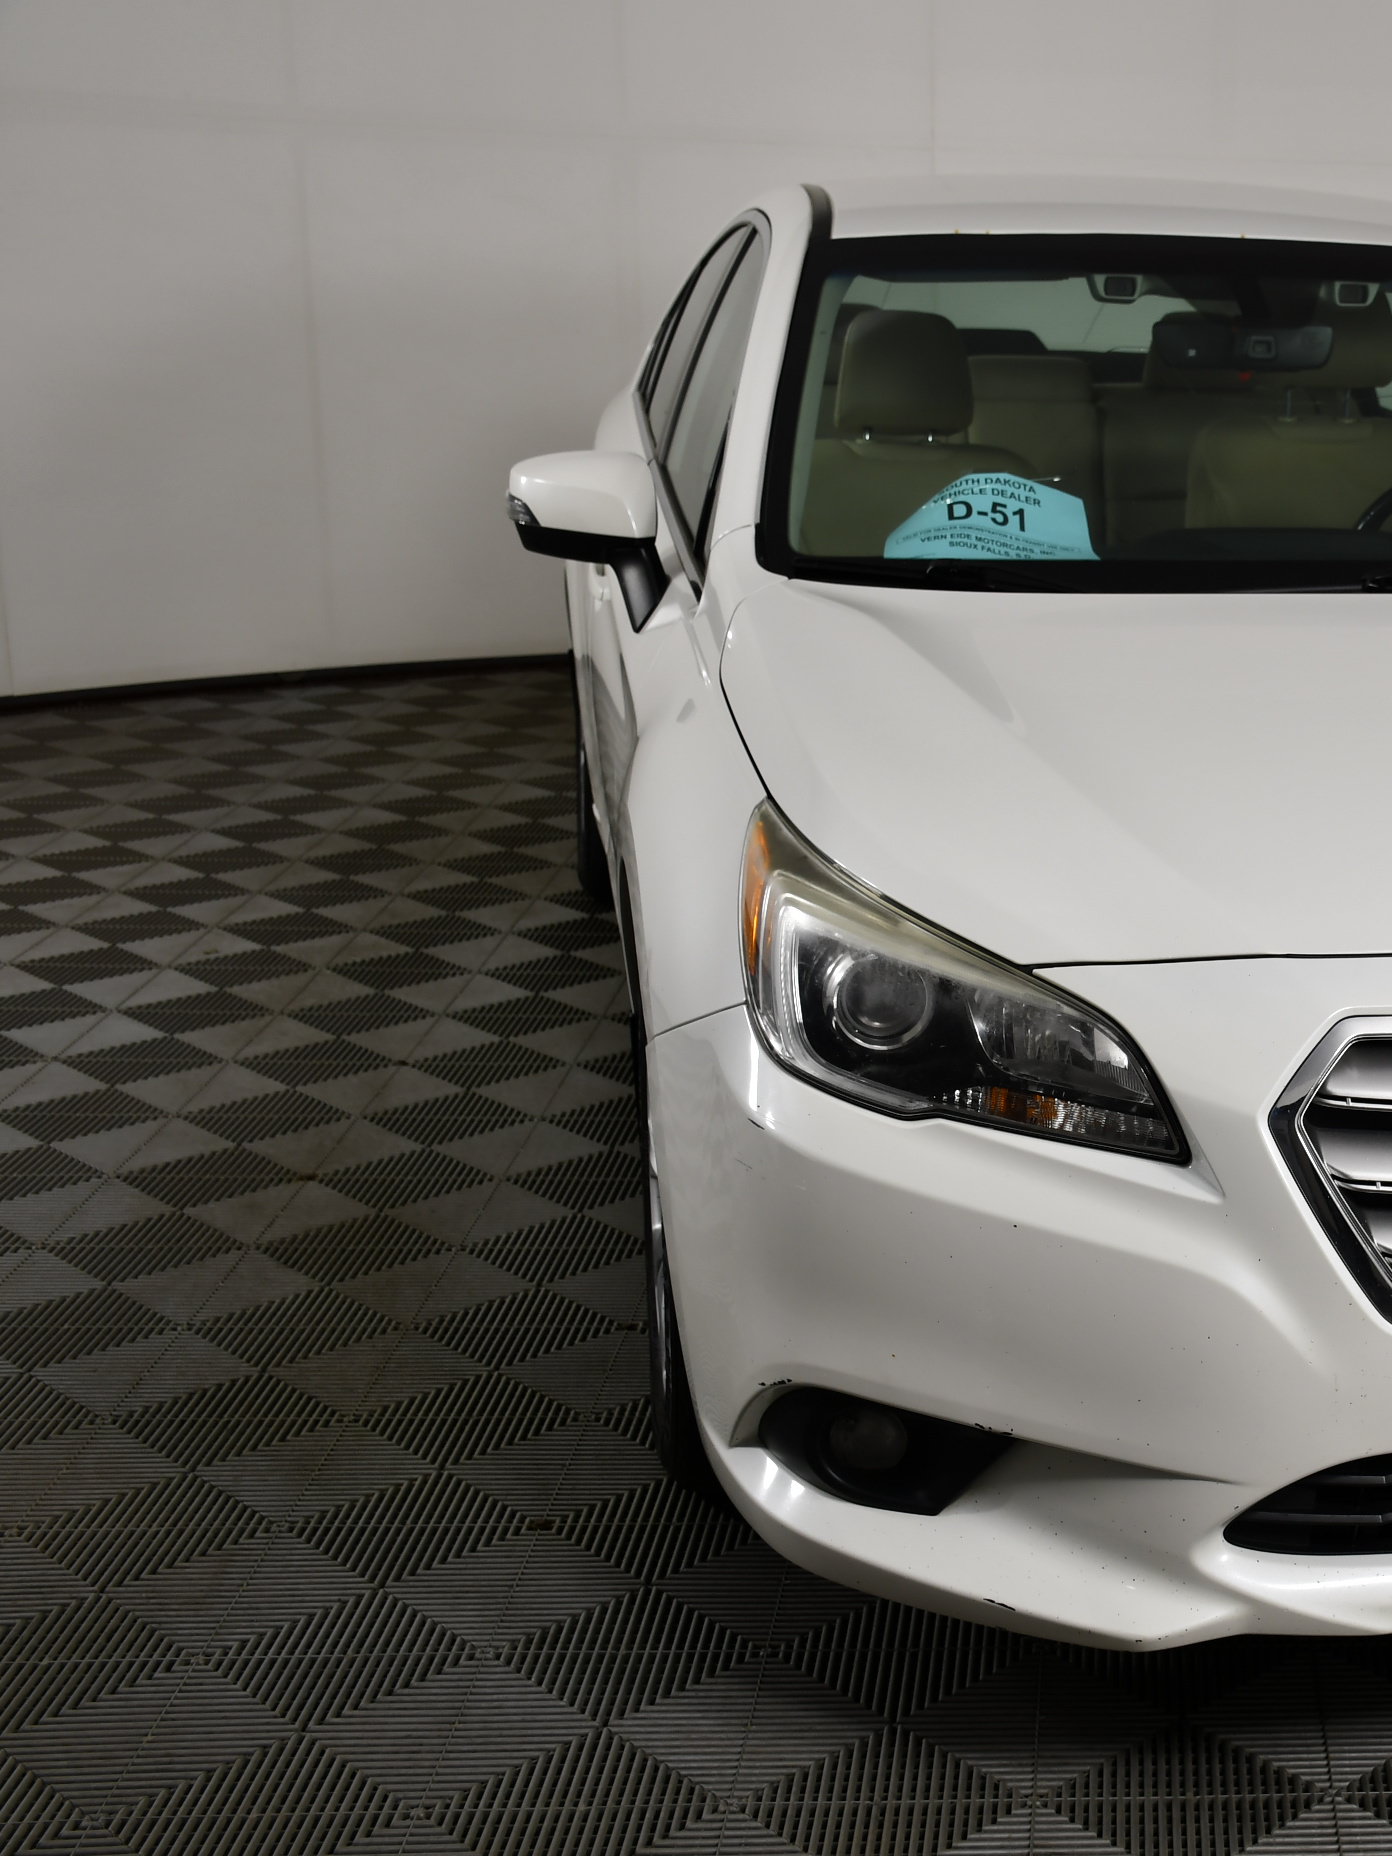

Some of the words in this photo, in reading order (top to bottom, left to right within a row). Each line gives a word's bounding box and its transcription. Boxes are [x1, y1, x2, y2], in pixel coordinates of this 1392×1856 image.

[985, 477, 1037, 495] DAKOTA
[932, 487, 988, 503] VEHICLE
[992, 488, 1042, 508] DEALER
[946, 500, 1026, 532] D-51
[920, 533, 948, 543] VERN
[950, 533, 973, 541] EIDE
[949, 541, 980, 551] SIOUX
